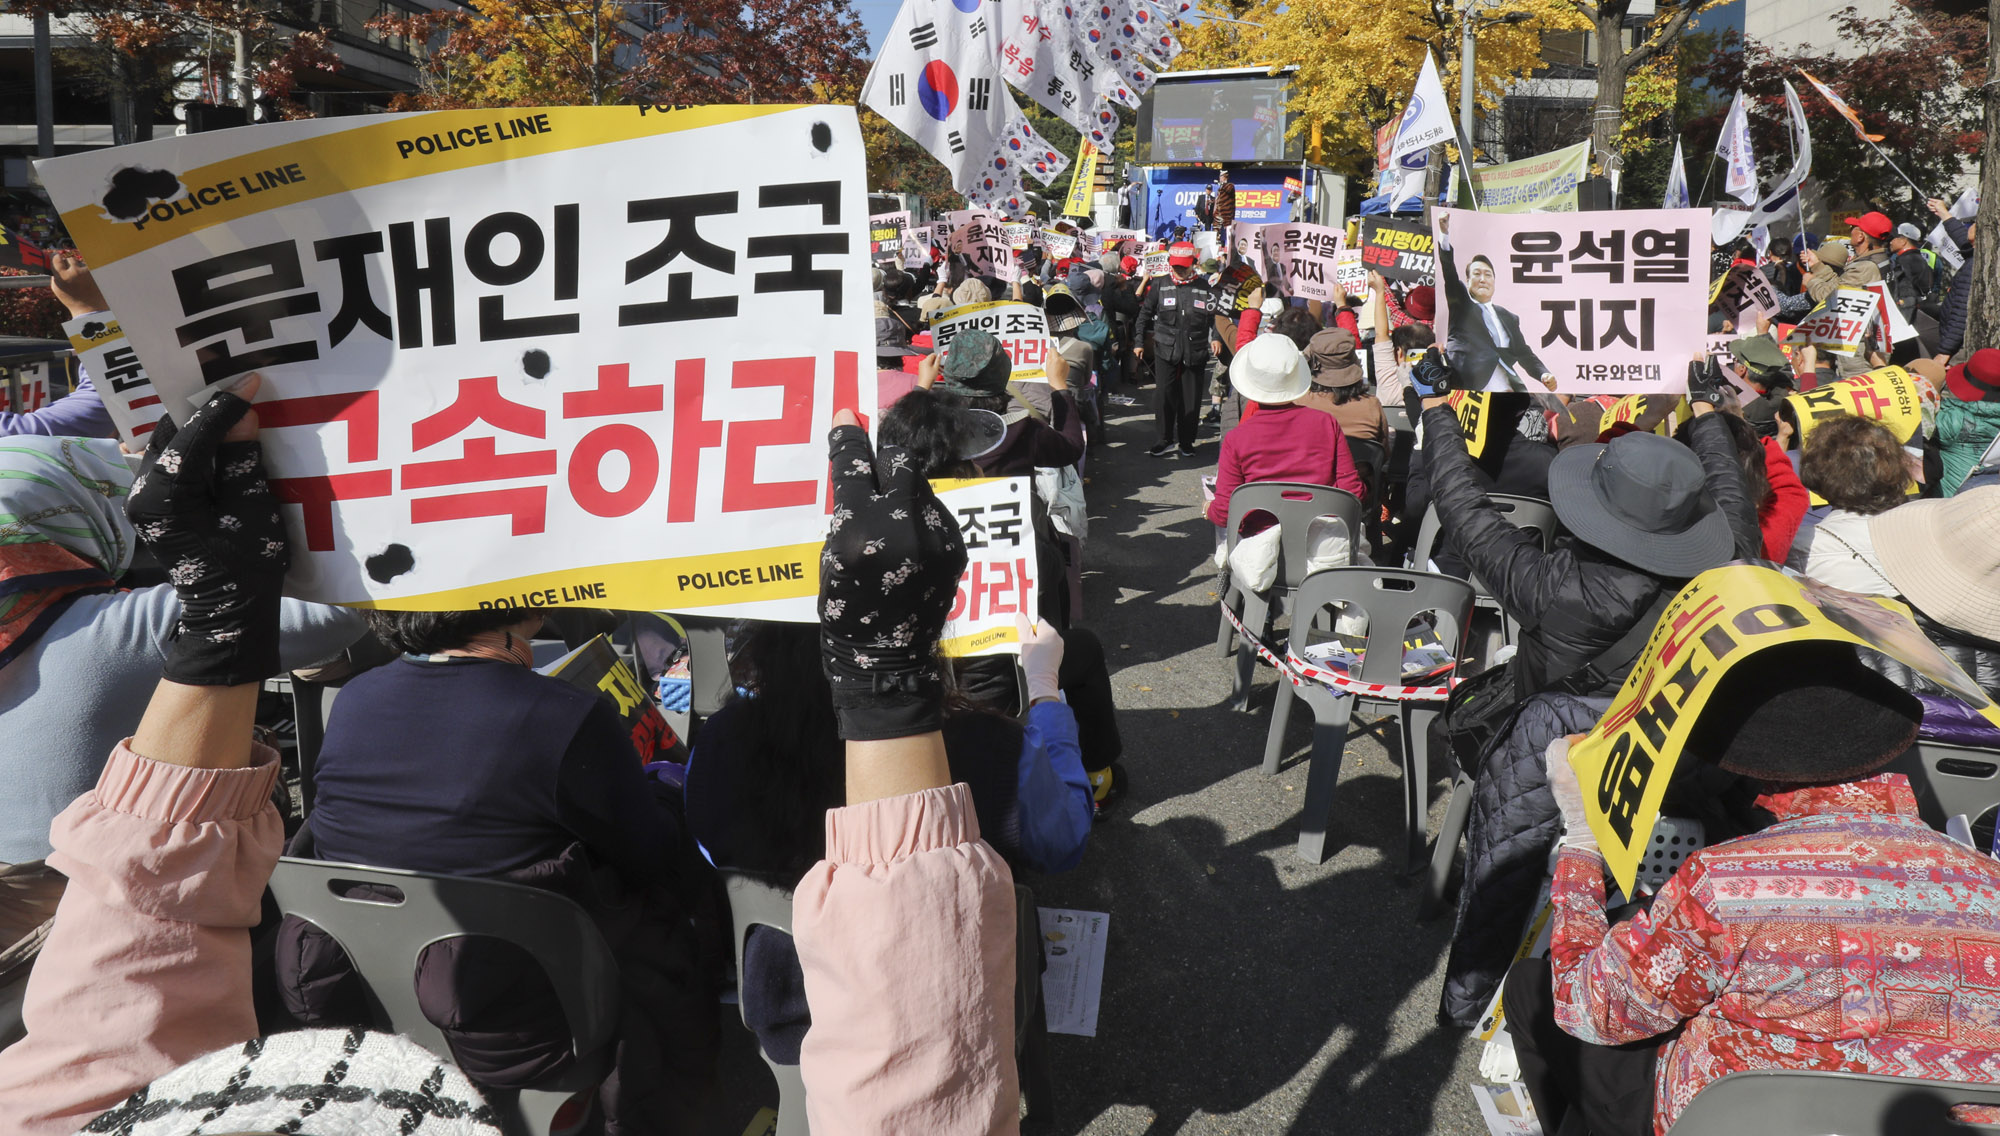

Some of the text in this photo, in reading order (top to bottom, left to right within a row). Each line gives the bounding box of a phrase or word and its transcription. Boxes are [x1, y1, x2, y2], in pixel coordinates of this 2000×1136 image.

[1005, 44, 1077, 109] 복음 통일
[1069, 49, 1095, 82] 한국
[395, 113, 552, 160] POLICE LINE
[239, 163, 306, 195] LINE
[871, 228, 897, 242] 명아!
[967, 224, 1010, 247] 윤석열
[1284, 229, 1338, 259] 윤석열
[1371, 227, 1434, 254] 재명아!
[976, 246, 1008, 266] 지지
[1510, 228, 1690, 284] 윤석열
[171, 181, 849, 386] 문재인 조국
[1290, 258, 1325, 285] 지지
[1830, 297, 1872, 317] 조국
[1006, 314, 1044, 334] 조국
[1541, 298, 1655, 351] 지지
[1576, 364, 1661, 382] 자유와연대
[257, 350, 869, 552] 구속하라
[958, 502, 1022, 549] 조국
[677, 562, 804, 592] POLICE LINE
[562, 582, 607, 605] LINE
[970, 635, 992, 648] POLICE
[1598, 603, 1811, 851] 이재명
